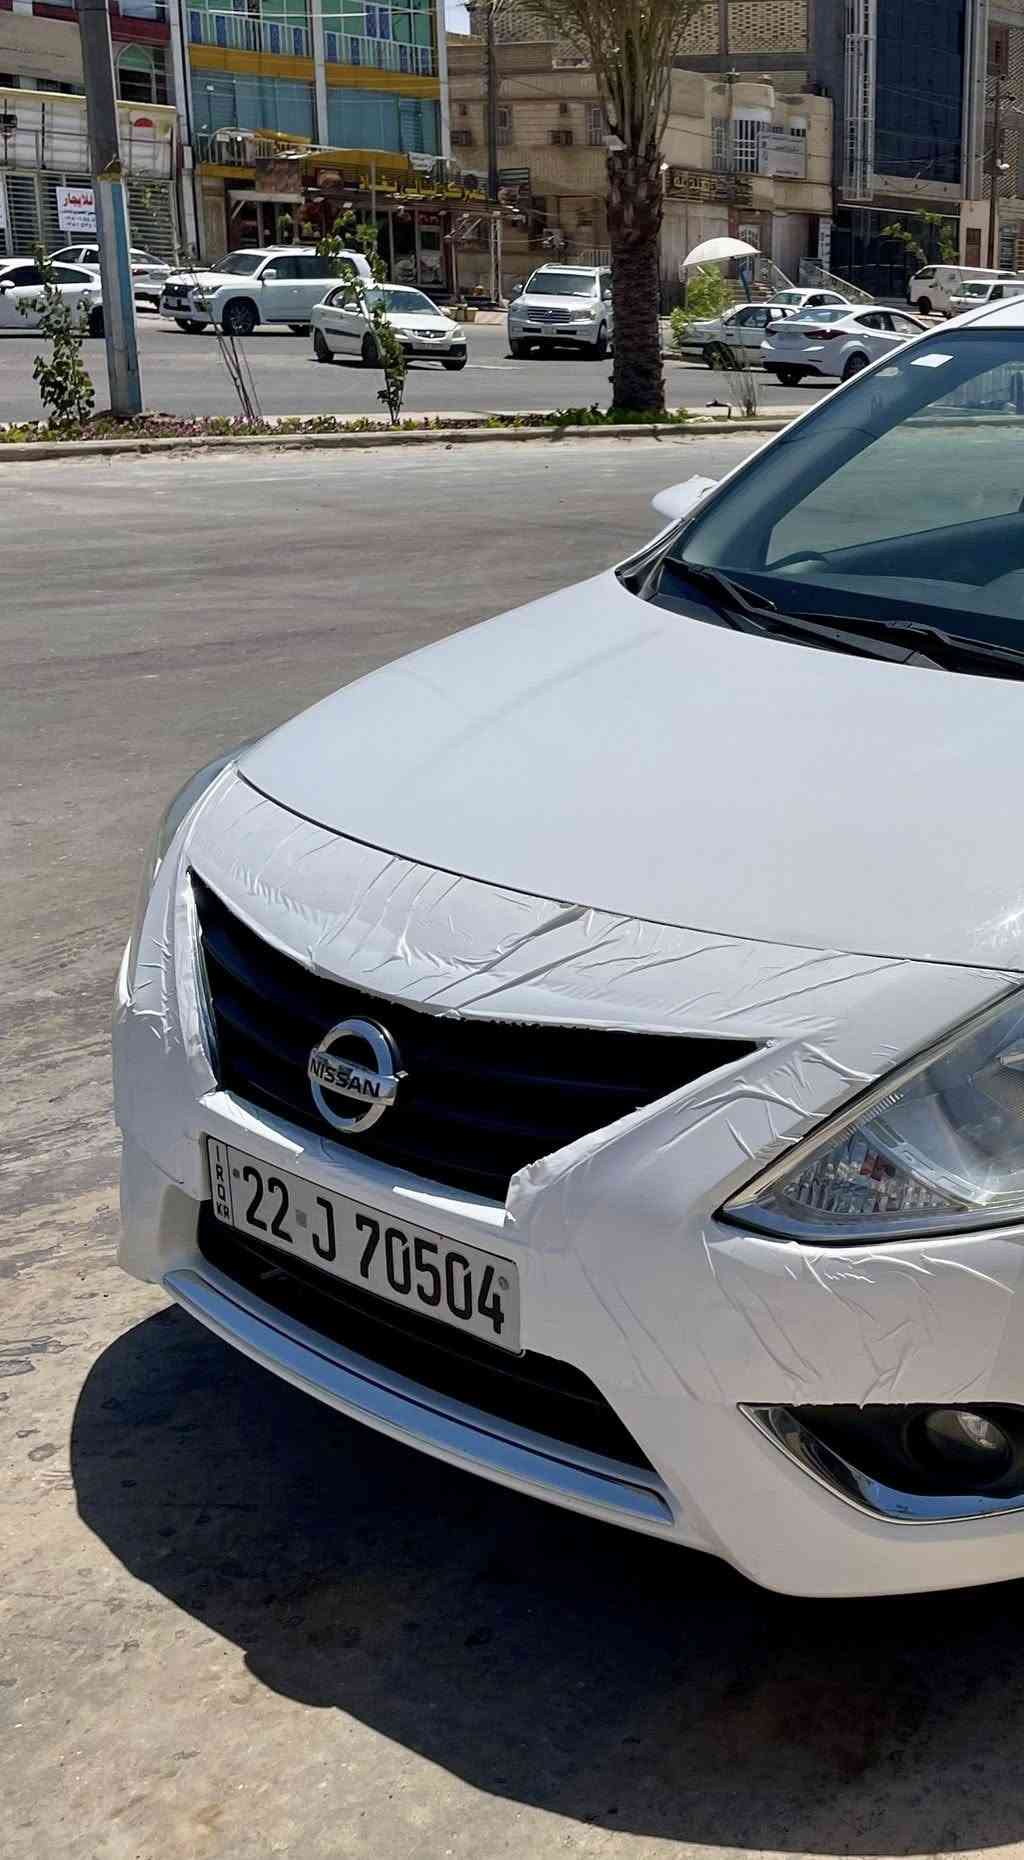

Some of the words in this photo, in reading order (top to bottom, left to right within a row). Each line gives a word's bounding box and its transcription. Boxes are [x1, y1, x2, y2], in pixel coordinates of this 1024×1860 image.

[309, 1057, 381, 1099] NISSAN
[243, 1165, 293, 1243] 22
[311, 1195, 336, 1263] J
[355, 1212, 505, 1335] 70504
